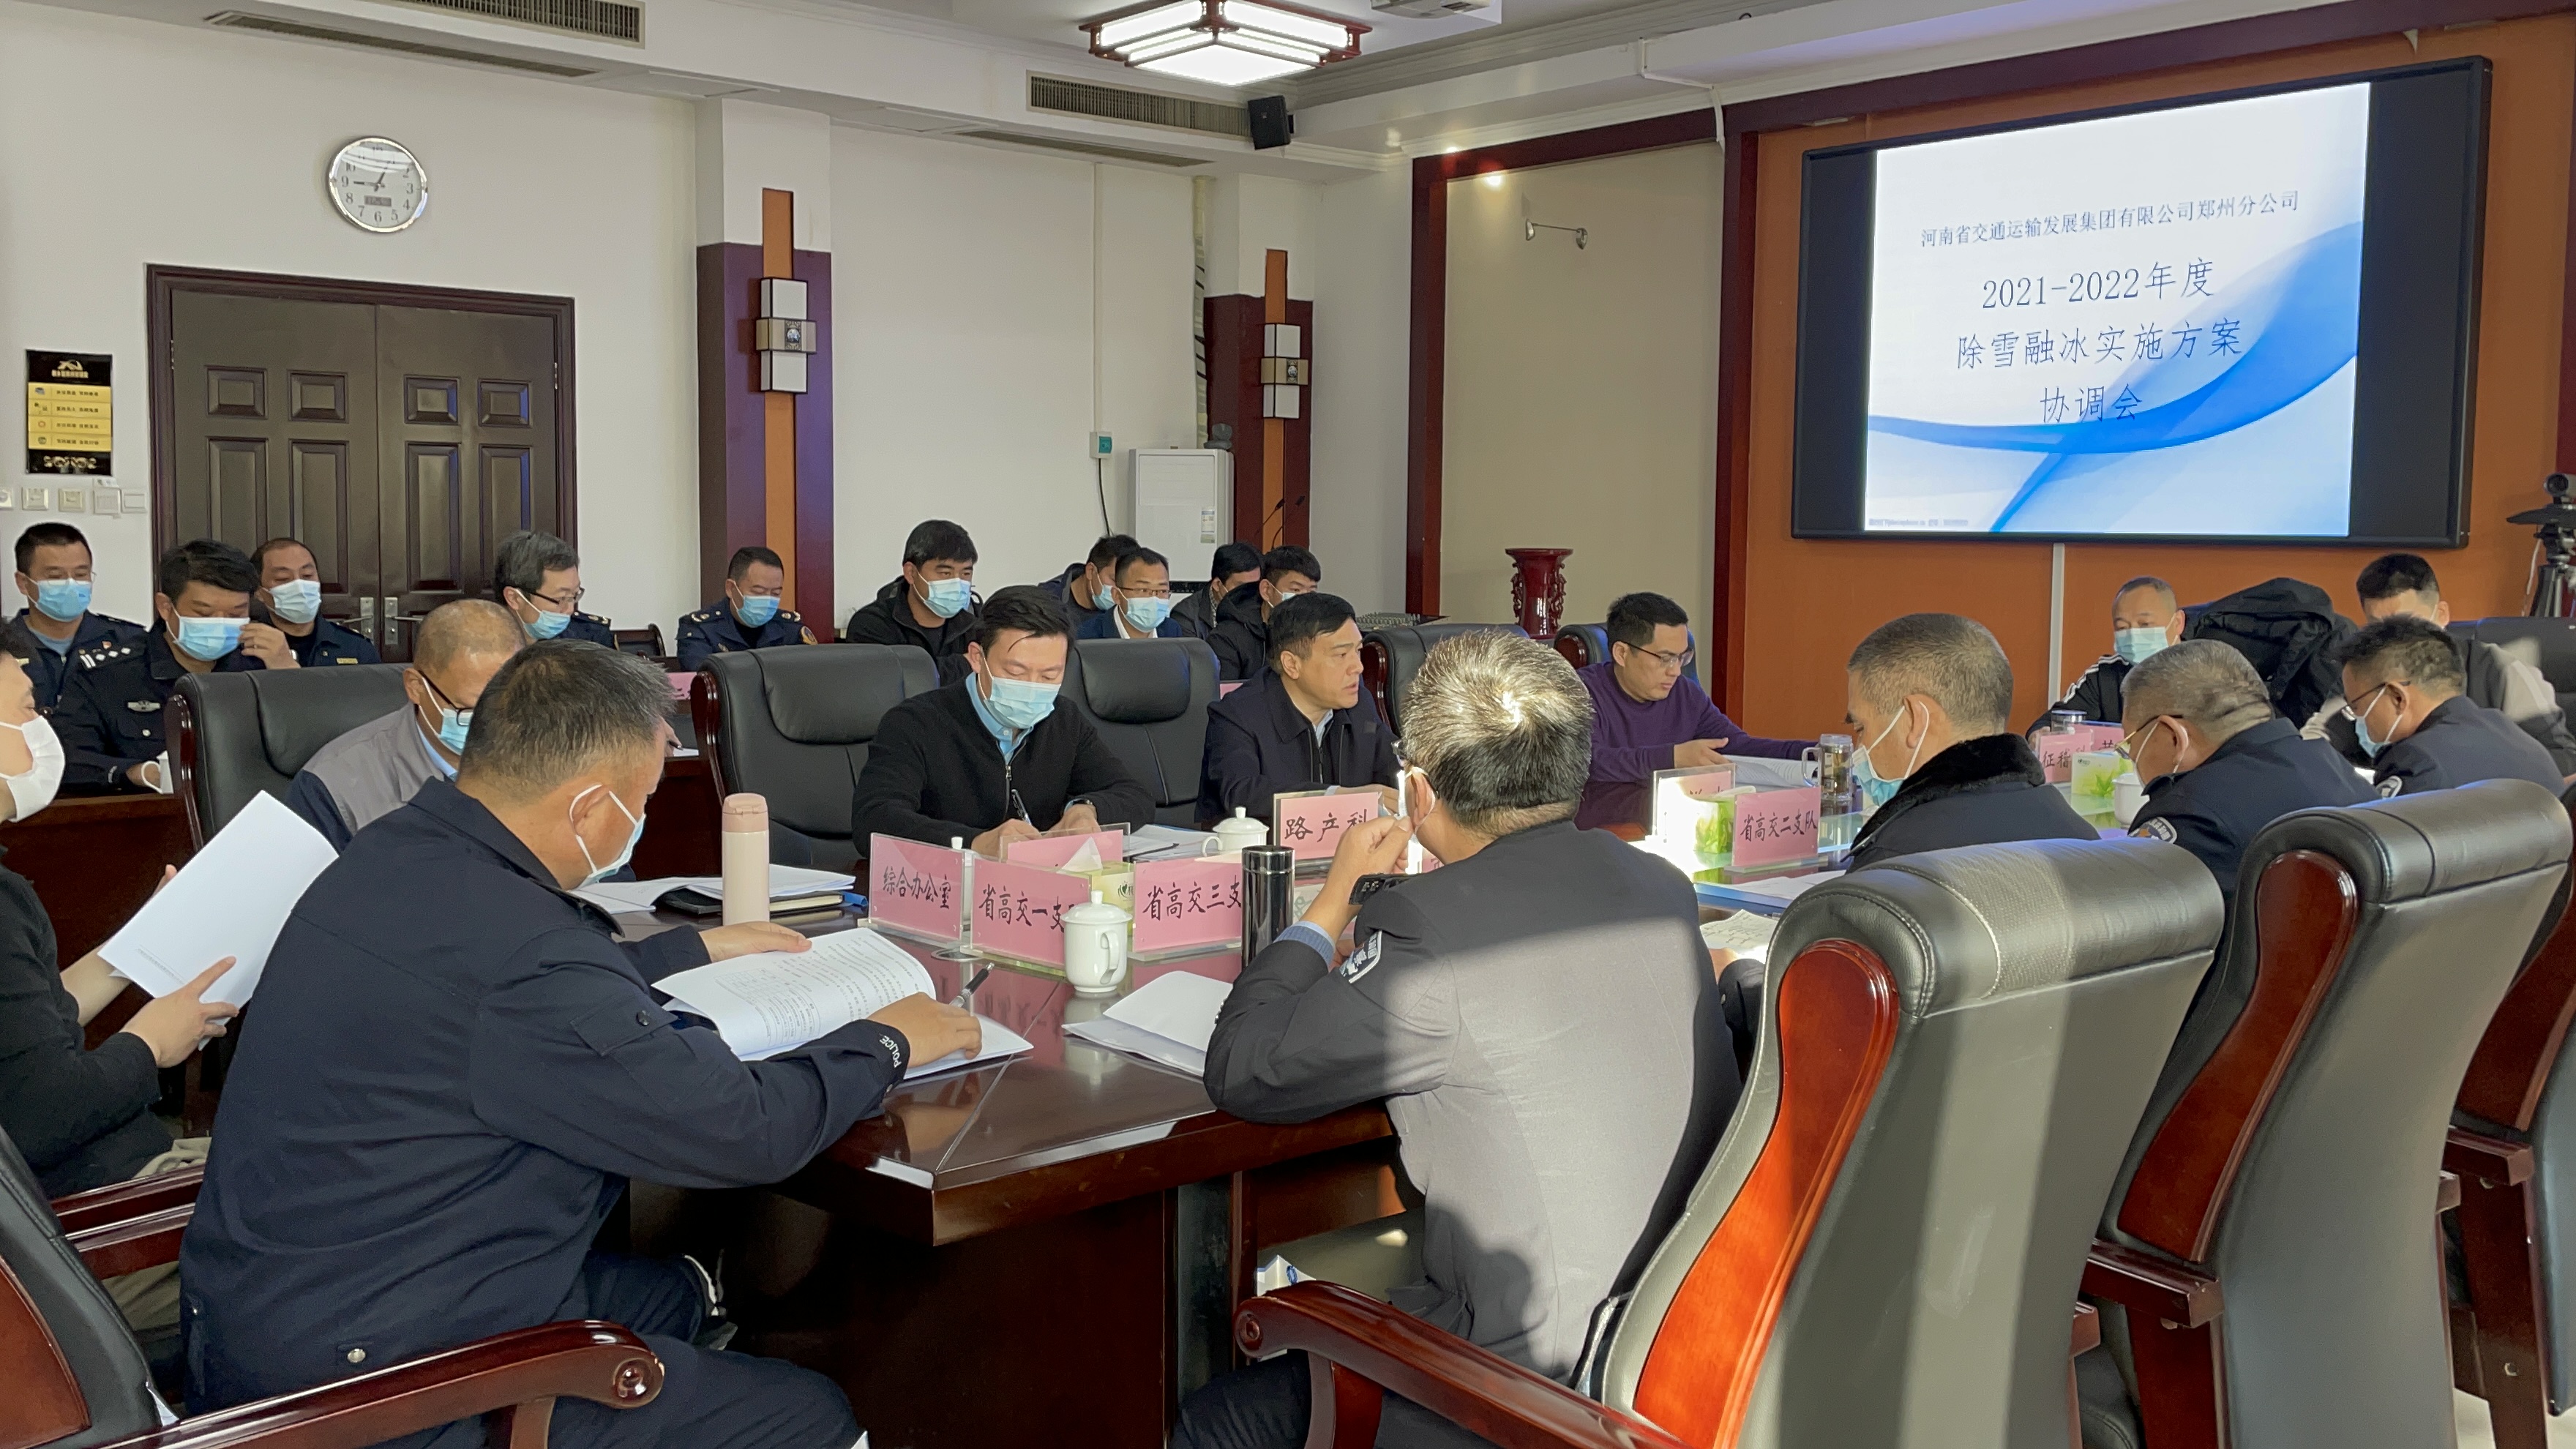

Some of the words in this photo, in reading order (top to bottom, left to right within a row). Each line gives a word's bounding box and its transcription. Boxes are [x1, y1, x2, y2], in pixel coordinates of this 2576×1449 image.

[341, 176, 349, 187] 9
[345, 192, 353, 203] 8
[406, 182, 413, 194] 3
[358, 205, 365, 217] 7
[374, 211, 382, 222] 6
[391, 209, 398, 220] 5
[402, 198, 410, 210] 4
[1920, 190, 2299, 247] 河南省交通运输发展集团有限公司郑州分公司
[1982, 257, 2214, 309] 2021-2022年度
[1957, 318, 2242, 369] 除雪融冰实施方案
[2040, 383, 2143, 423] 协调会
[1740, 809, 1818, 842] 省高交二支队
[883, 865, 951, 910] 综合办公室
[978, 883, 1075, 933] 省高交一支
[879, 1034, 902, 1068] POLICE
